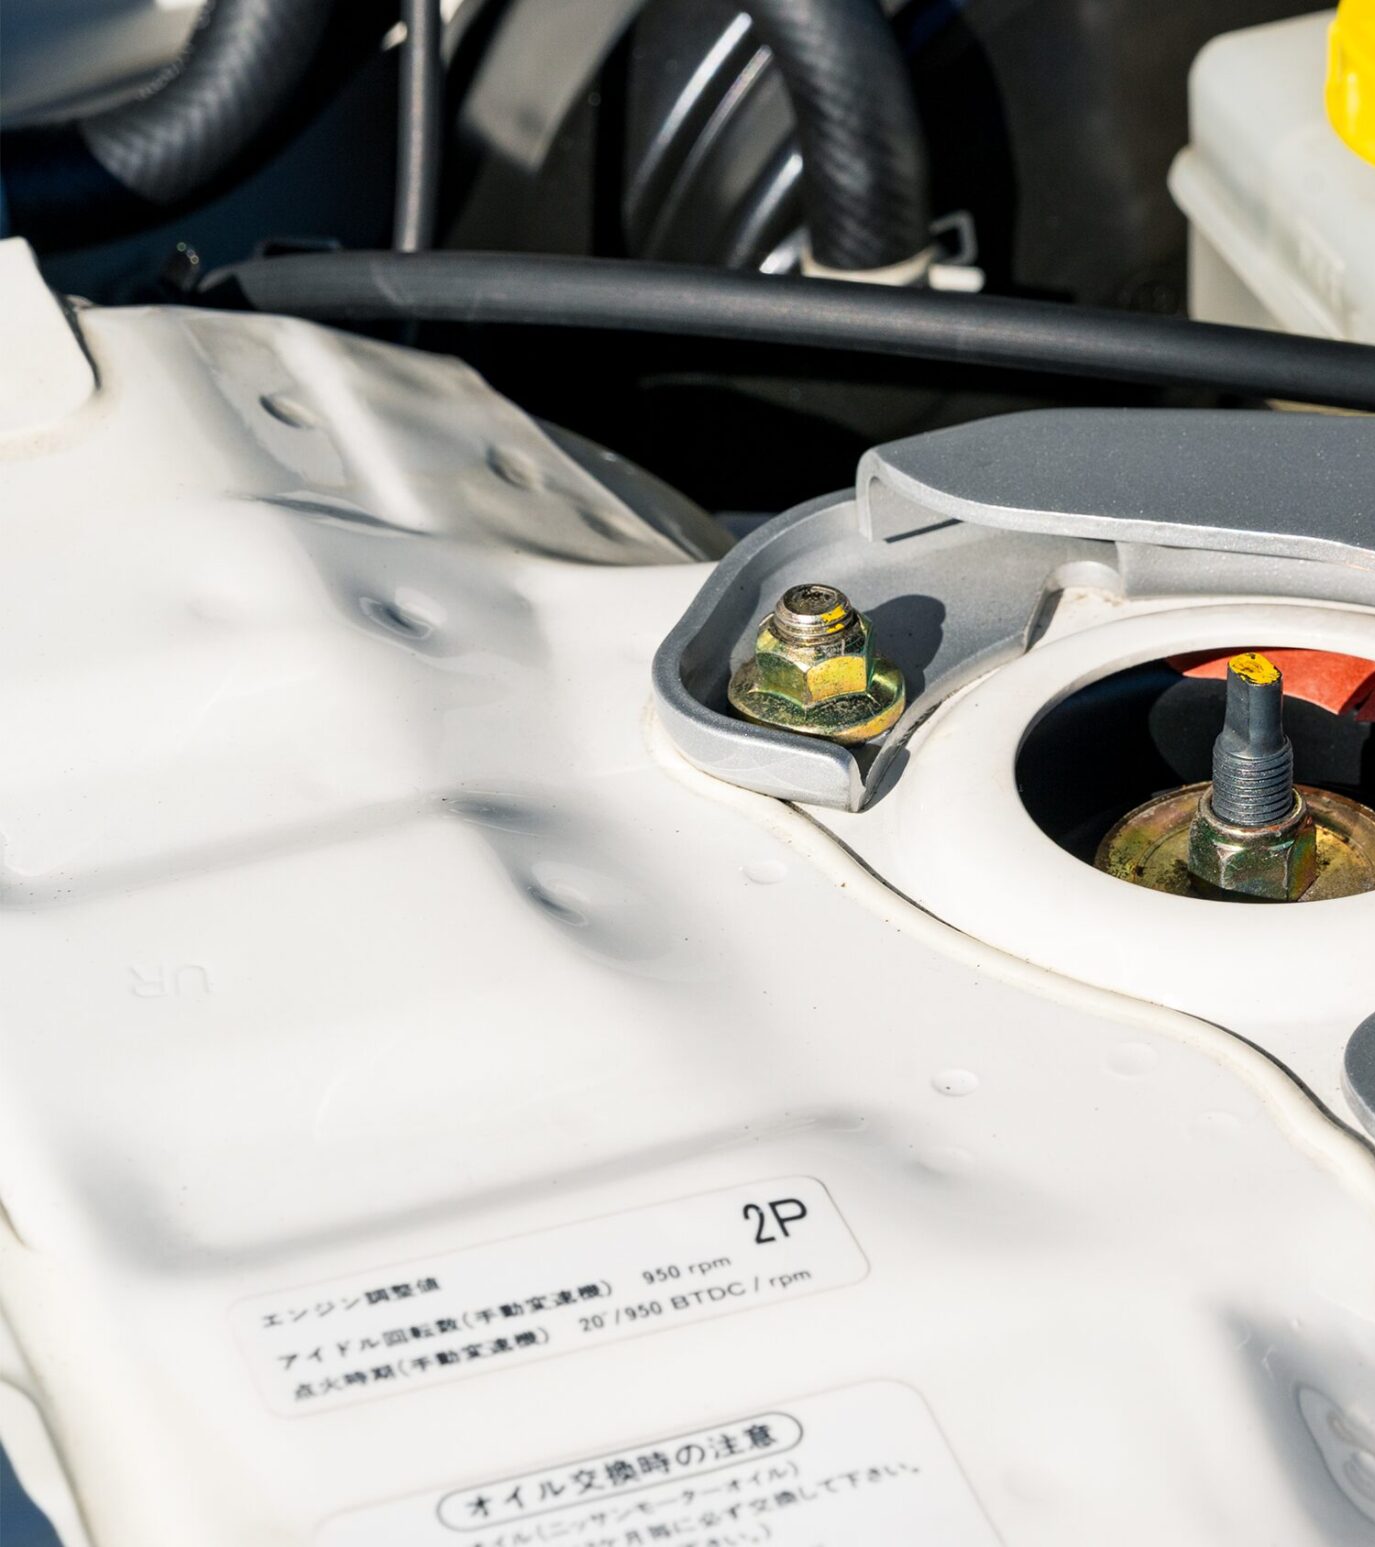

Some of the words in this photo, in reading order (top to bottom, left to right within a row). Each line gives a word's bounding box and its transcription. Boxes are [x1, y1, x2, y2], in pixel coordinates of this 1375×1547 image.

[743, 1198, 808, 1244] 2P
[642, 1265, 681, 1285] 950
[688, 1255, 732, 1274] rpm
[670, 1282, 747, 1309] BTDC
[768, 1269, 812, 1288] rpm
[262, 1277, 440, 1328] エンジン調整値
[466, 1424, 777, 1517] オイル交換時の注意
